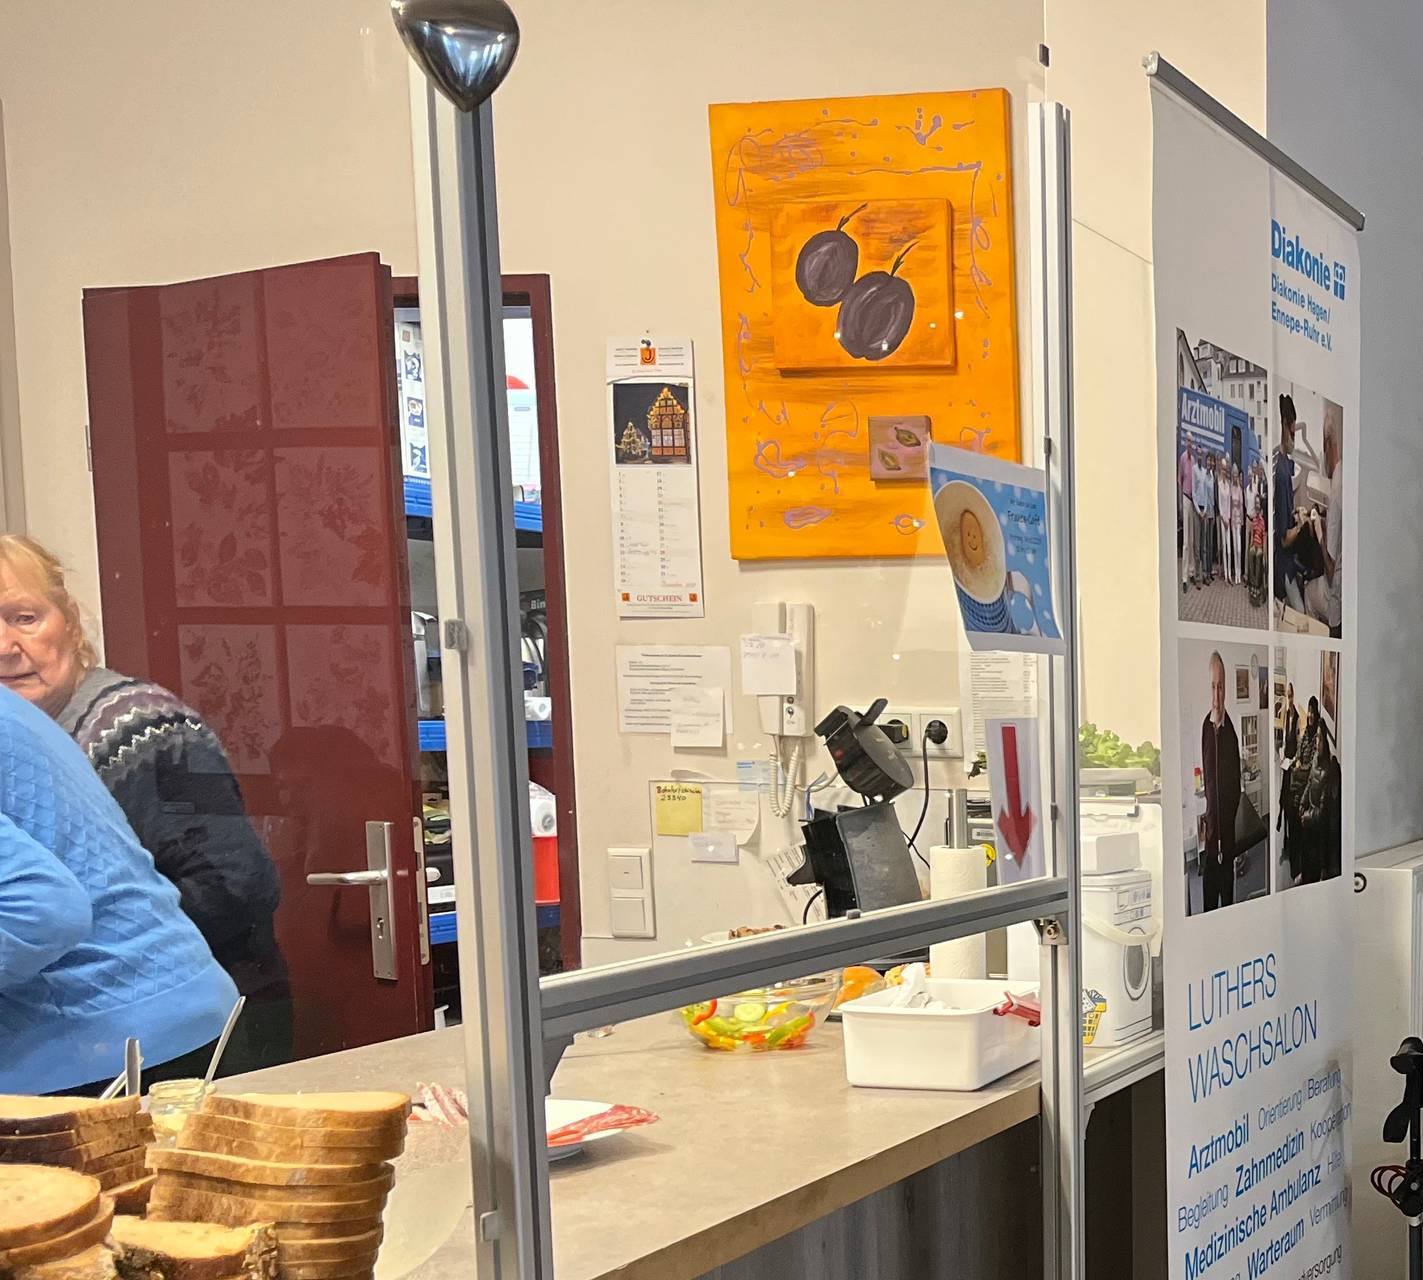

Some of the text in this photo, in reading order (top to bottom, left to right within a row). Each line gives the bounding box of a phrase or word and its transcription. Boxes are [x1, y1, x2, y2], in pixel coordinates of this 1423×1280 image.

[1271, 218, 1331, 291] Diakonie
[1271, 273, 1331, 324] Diakonie Hagen/
[1271, 300, 1332, 352] Ennepe-Ruhr e.V.
[1181, 392, 1225, 434] Arztmobil
[1188, 953, 1277, 1031] LUTHERS
[1188, 999, 1318, 1103] WASCHSALON
[1188, 1068, 1342, 1179] Arztmobil Orientierung Beratung
[1178, 1183, 1229, 1233] Begleitung
[1235, 1129, 1305, 1198] Zahnmedizin
[1185, 1203, 1267, 1280] Medizinische
[1269, 1163, 1322, 1220] Ambulanz
[1247, 1217, 1305, 1280] Warteraum
